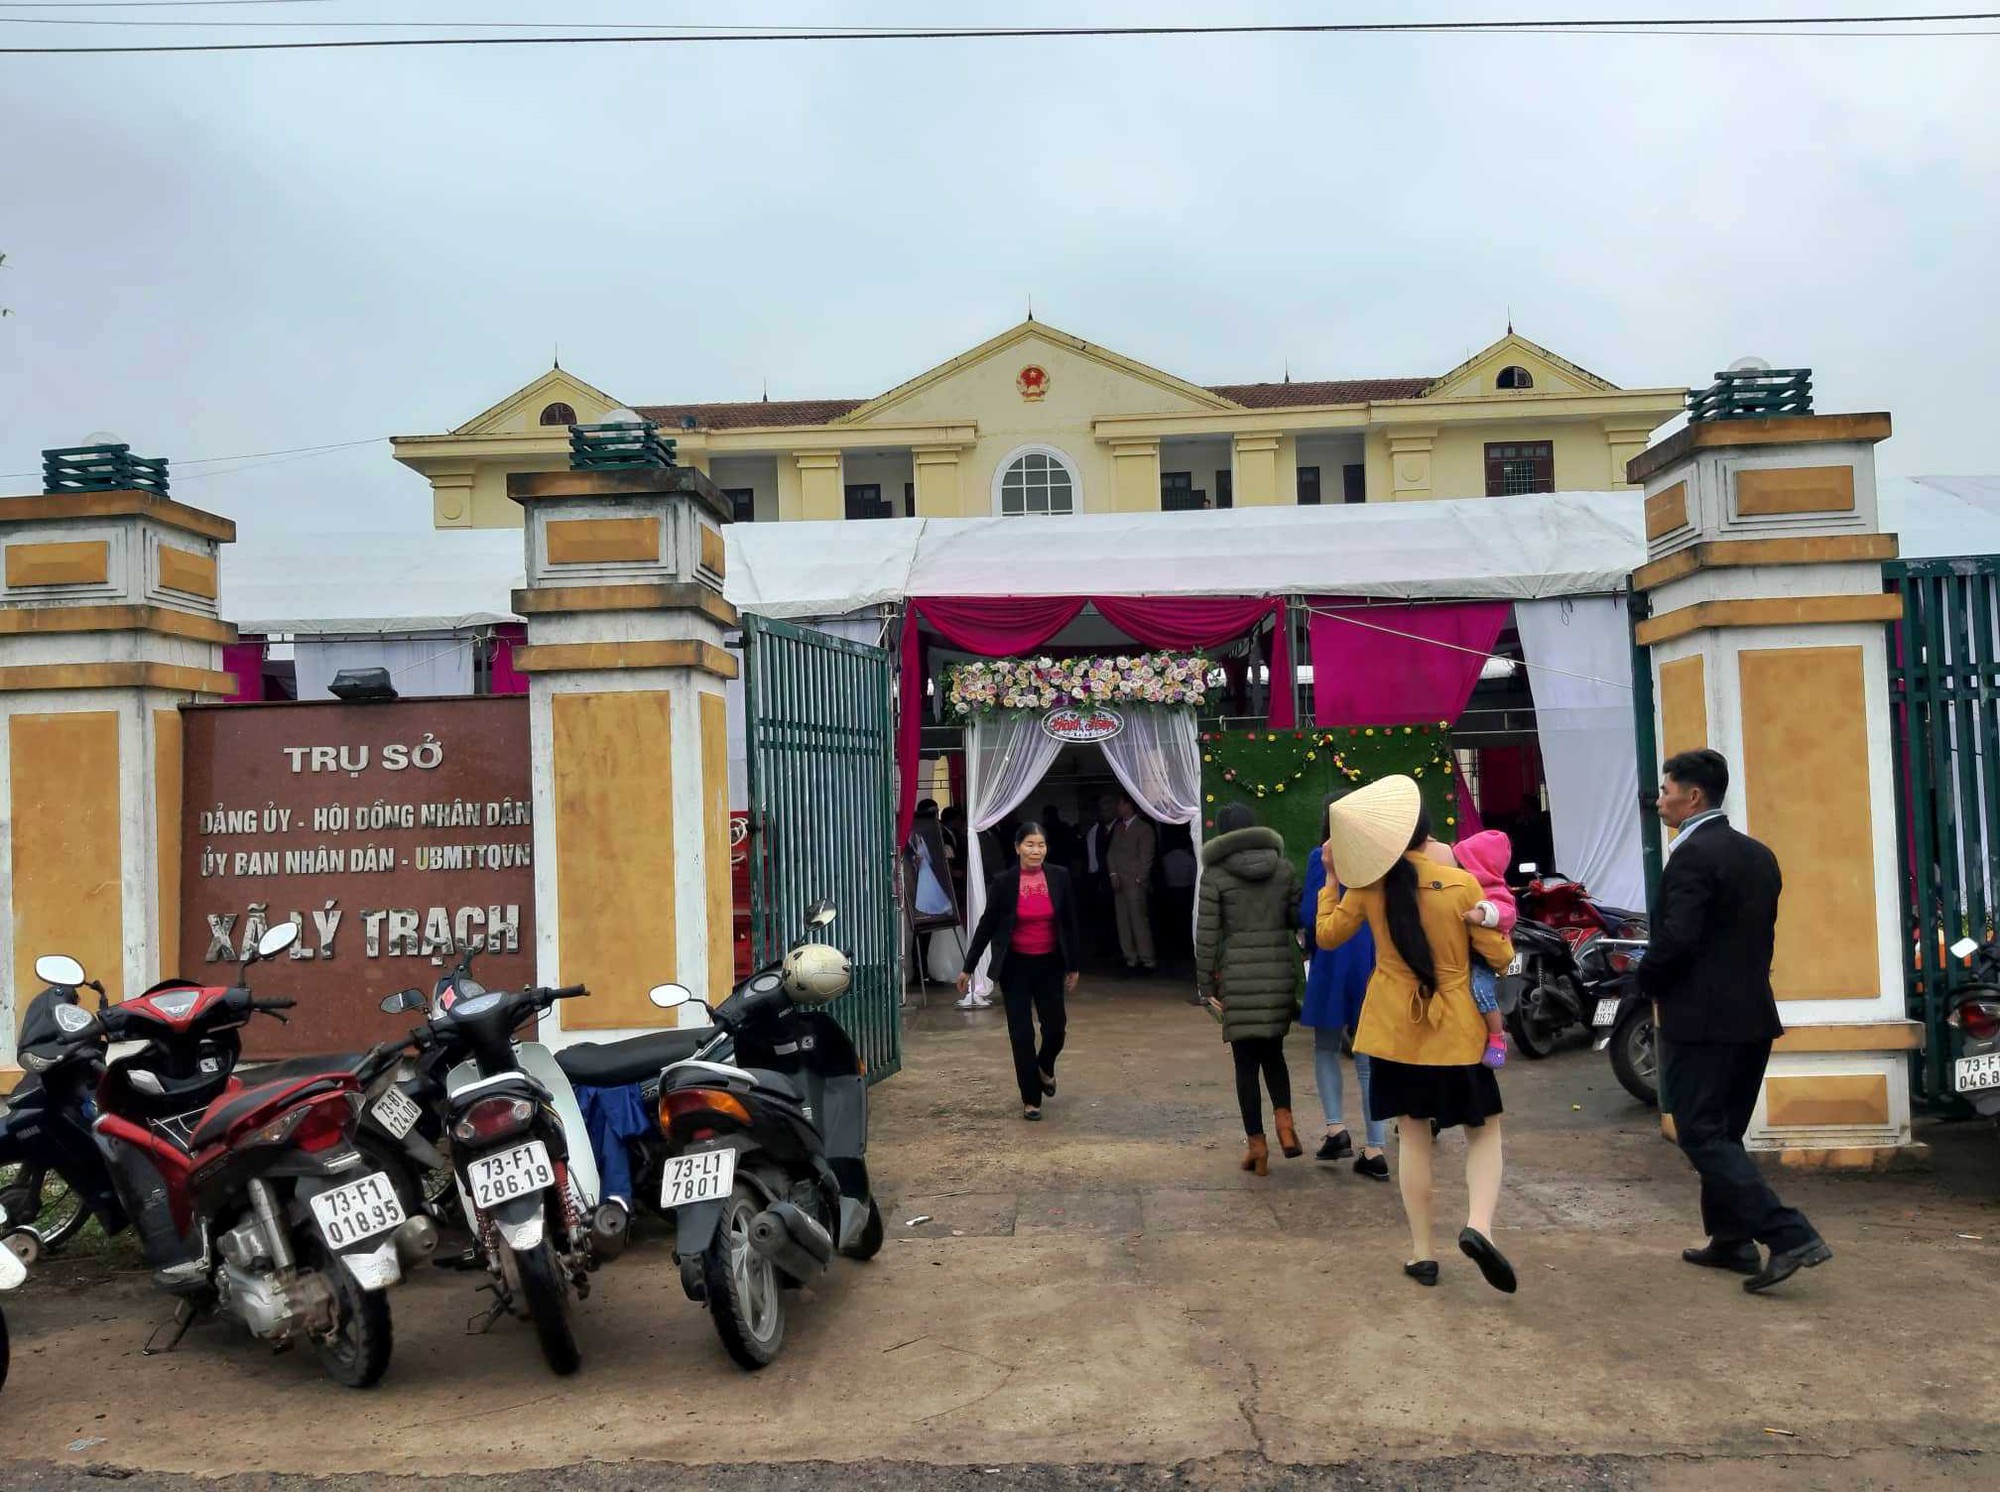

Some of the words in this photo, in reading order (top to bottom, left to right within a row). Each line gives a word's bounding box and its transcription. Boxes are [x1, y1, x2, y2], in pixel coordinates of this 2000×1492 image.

[283, 746, 369, 778] TRỤ
[381, 733, 443, 771] SỞ
[263, 801, 291, 833] ỦY
[314, 802, 350, 835] HỘI
[356, 798, 414, 830] ĐỒNG
[421, 798, 481, 827] NHÂN
[487, 797, 532, 826] DÂN
[201, 845, 228, 877] ỦY
[235, 852, 279, 876] BAN
[285, 845, 345, 874] NHÂN
[350, 843, 394, 872] DÂN
[415, 843, 531, 871] UBMTTQVN
[289, 899, 342, 959] LÝ
[360, 904, 520, 965] TRẠCH
[1960, 1070, 2000, 1089] 046.8
[1965, 1055, 2000, 1073] 73-F
[480, 1147, 535, 1180] 73-F1
[674, 1154, 720, 1180] 73-L1
[325, 1179, 382, 1216] 73-F1
[480, 1164, 549, 1204] 286.19
[672, 1175, 719, 1202] 7801
[328, 1199, 400, 1243] 018.95
